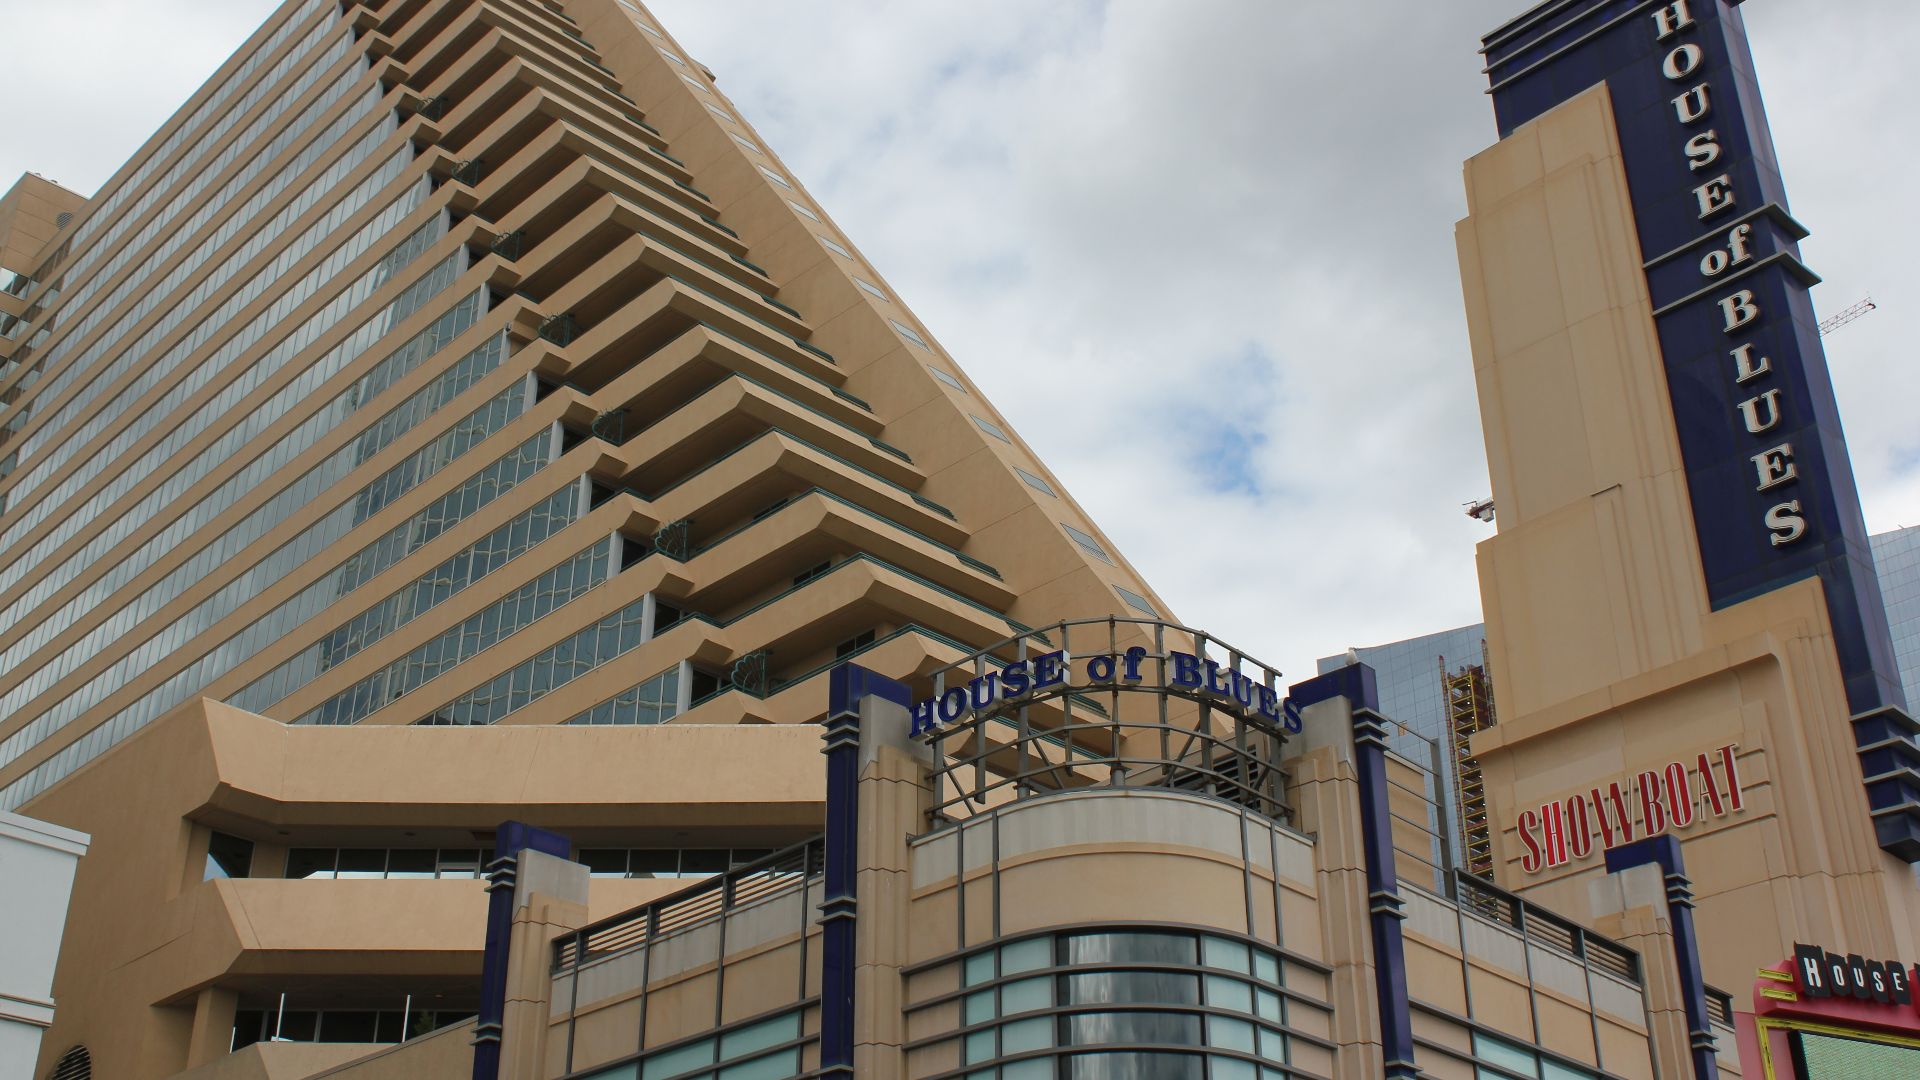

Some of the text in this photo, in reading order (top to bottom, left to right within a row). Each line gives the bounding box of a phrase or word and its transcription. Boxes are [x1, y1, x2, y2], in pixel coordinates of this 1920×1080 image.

[1651, 0, 1805, 546] HOUSE of BLUES
[909, 646, 1303, 738] HOUSE of BLUES
[1516, 743, 1746, 874] SHOWBOAT
[1804, 957, 1904, 992] HOUSE
